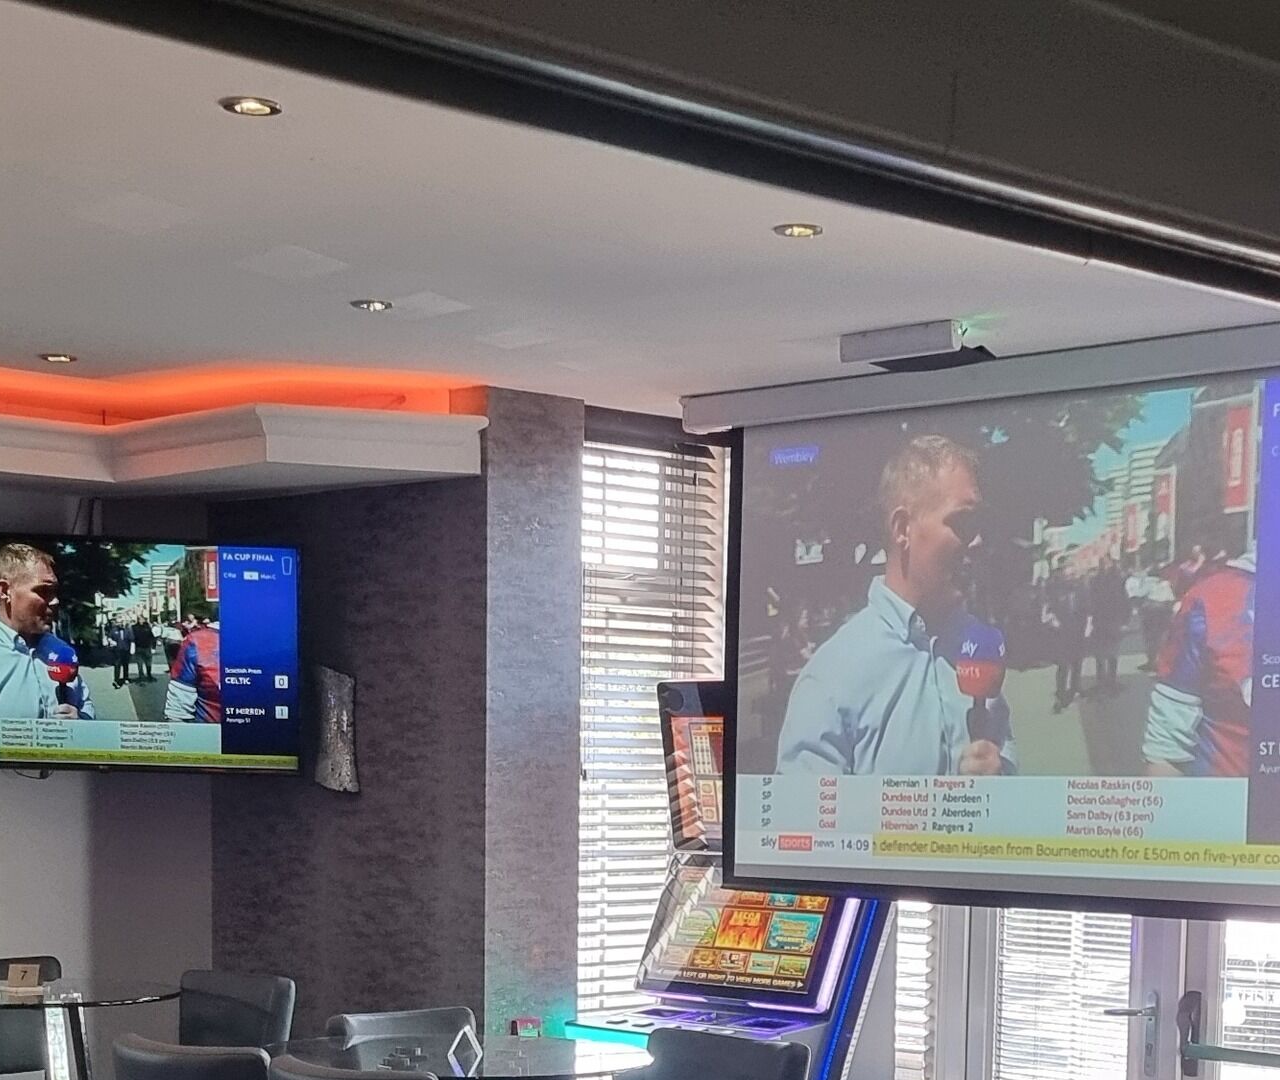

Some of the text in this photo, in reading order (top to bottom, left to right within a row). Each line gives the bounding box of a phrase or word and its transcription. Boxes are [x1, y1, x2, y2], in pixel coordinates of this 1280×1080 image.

[234, 553, 251, 561] CUP
[252, 554, 274, 562] FINAL
[225, 677, 284, 687] CELTIC 0
[225, 707, 234, 715] ST
[1259, 741, 1275, 756] ST
[820, 778, 837, 787] Goal
[882, 778, 920, 788] Hibernian
[933, 779, 966, 791] Rangers
[969, 779, 974, 788] 2
[1067, 781, 1153, 792] Nicolas Raskin (50)
[820, 792, 837, 801] Goal
[882, 793, 912, 802] Dundee
[913, 793, 928, 803] Utd
[942, 793, 982, 803] Aberdeen
[1067, 795, 1164, 809] Declan Gallagher (56)
[819, 806, 836, 815] Goal
[881, 806, 911, 816] Dundee
[913, 806, 928, 817] Utd
[931, 808, 937, 817] 2
[941, 807, 981, 817] Aberdeen
[1066, 810, 1154, 823] Sam Dalby (63 pen)
[819, 820, 836, 829] Goal
[881, 820, 973, 834] Hibernian 2 Rangers 2
[1066, 826, 1144, 838] Martin Boyle (66)
[761, 836, 869, 851] sky sports news 14:09
[880, 840, 928, 852] defender
[930, 841, 959, 853] Dean
[962, 842, 1004, 857] Huijsen
[1006, 844, 1033, 856] from
[1036, 844, 1118, 858] Bournemouth
[1120, 847, 1140, 859] for
[1183, 851, 1199, 862] on
[1203, 849, 1260, 866] five-year
[20, 970, 28, 981] 7
